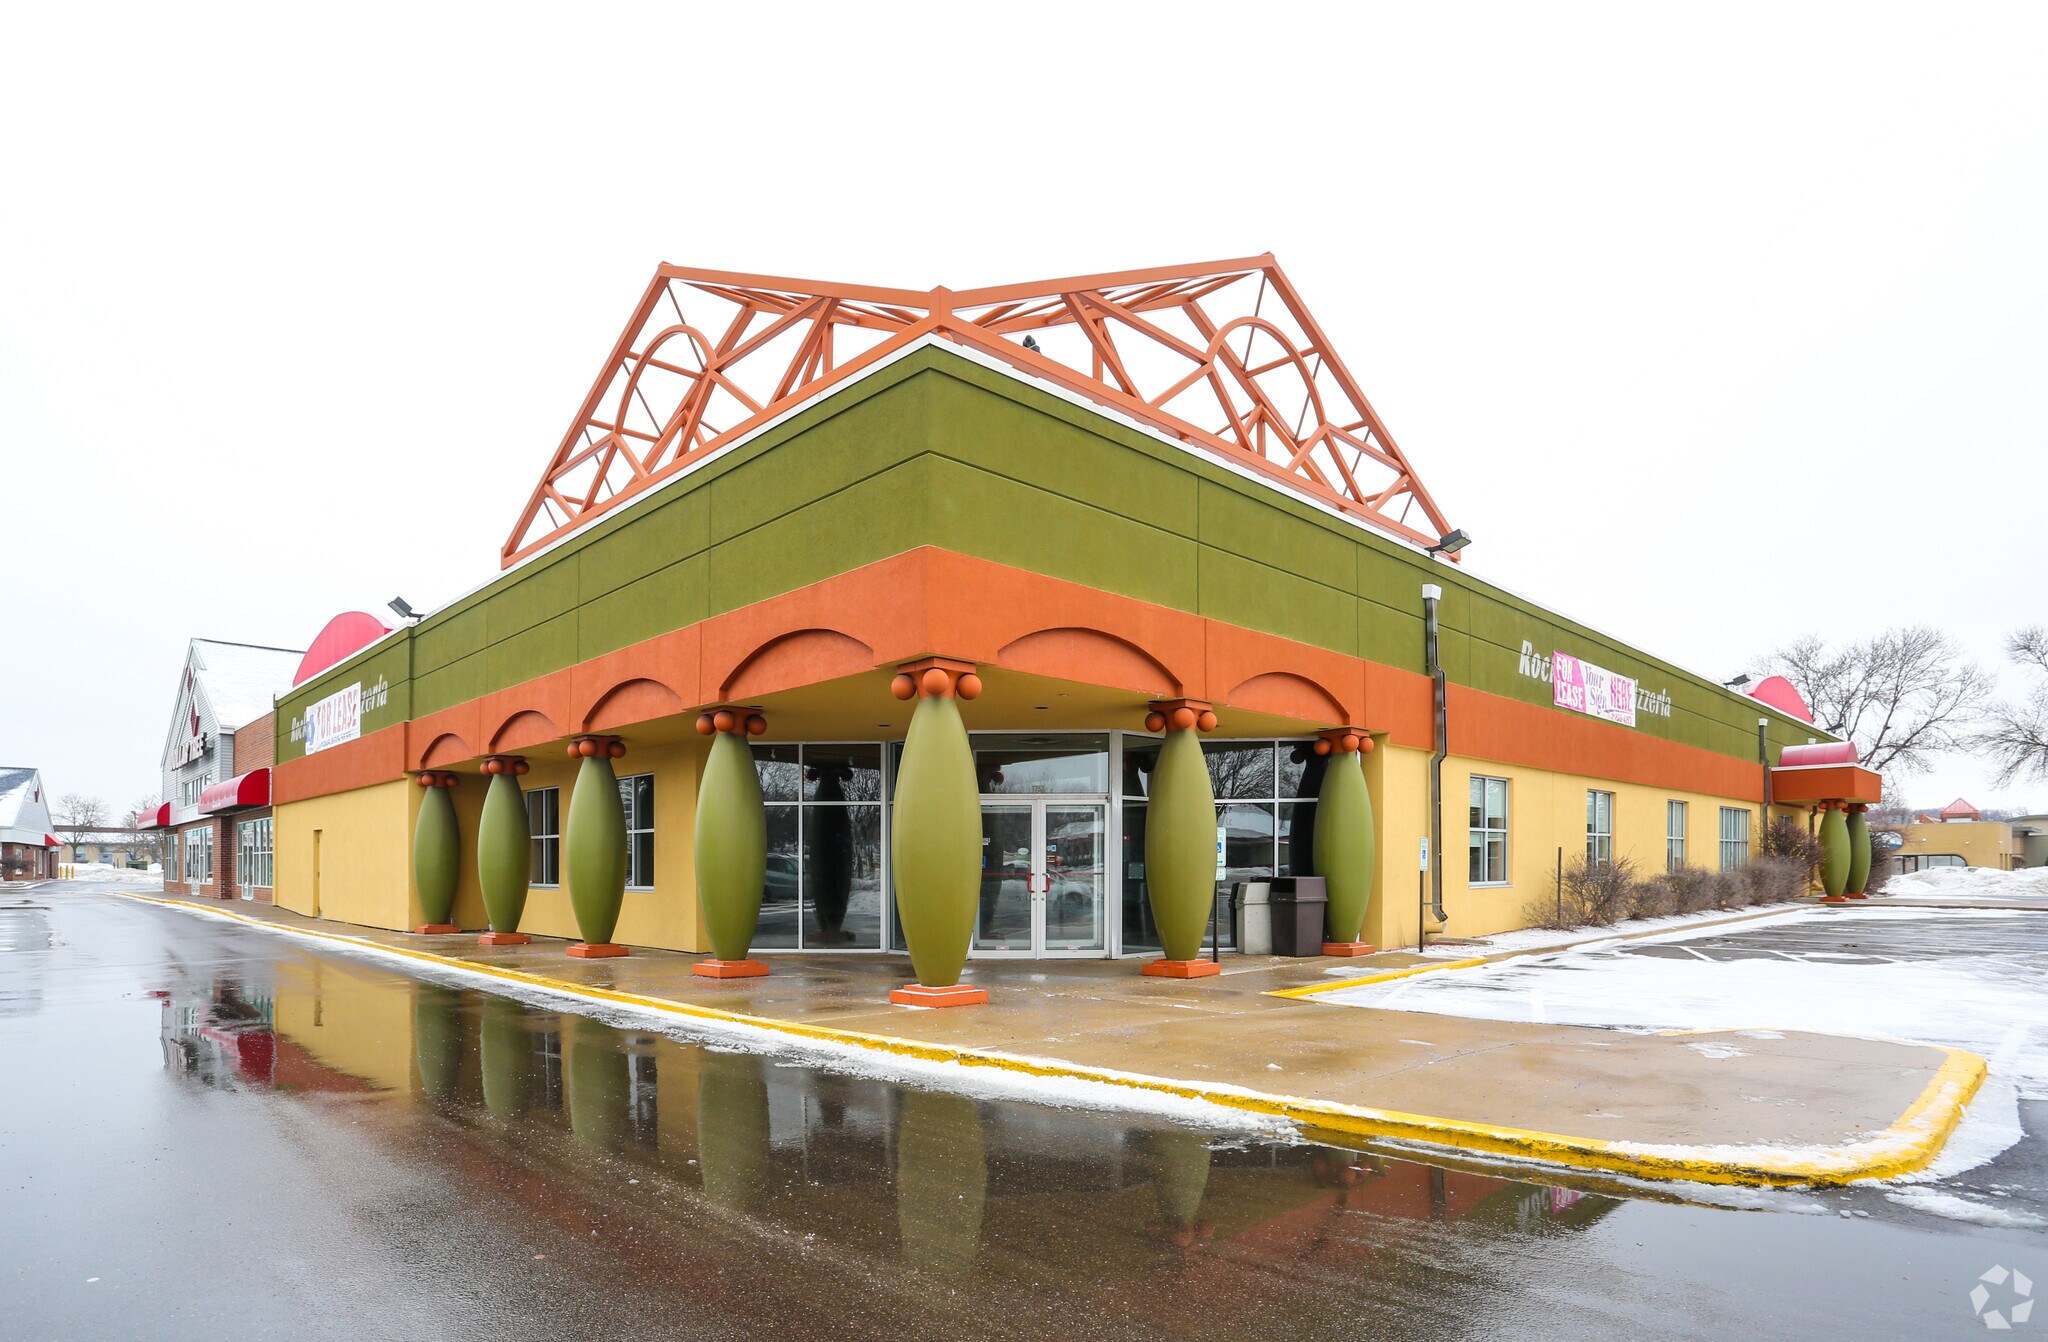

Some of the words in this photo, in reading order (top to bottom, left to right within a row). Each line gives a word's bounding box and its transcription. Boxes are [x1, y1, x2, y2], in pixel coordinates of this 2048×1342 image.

[1556, 655, 1573, 682] FOR
[1584, 665, 1604, 688] Your
[1557, 680, 1583, 709] LEASE
[1590, 688, 1607, 715] Sign
[1610, 675, 1632, 711] HERE
[316, 702, 331, 740] FOR
[333, 689, 358, 734] LEASE
